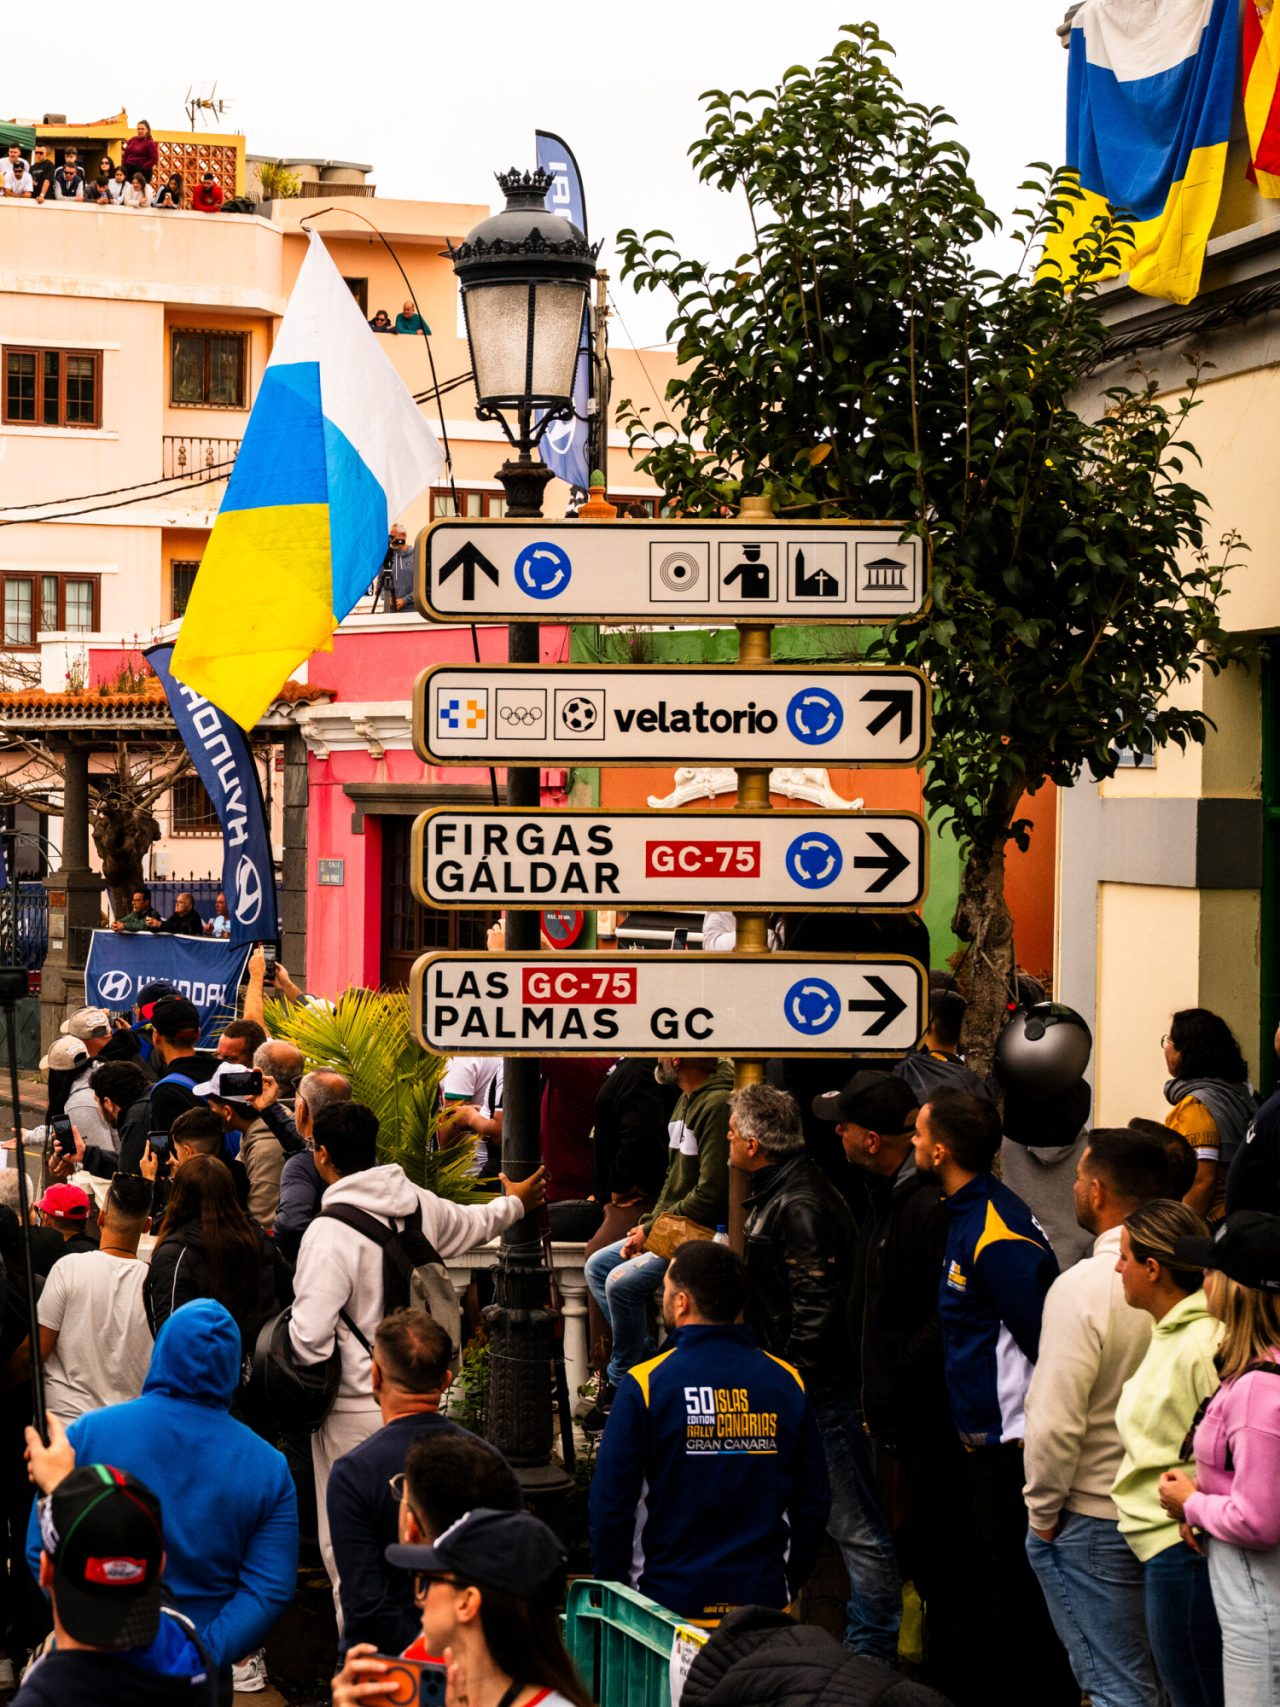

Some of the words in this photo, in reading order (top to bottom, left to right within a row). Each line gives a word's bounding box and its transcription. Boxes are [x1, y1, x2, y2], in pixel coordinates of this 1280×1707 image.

[614, 701, 778, 735] velatorio
[435, 824, 614, 856] FIRGAS
[651, 846, 755, 872] GC-75
[435, 856, 621, 894] GÁLDAR
[435, 970, 509, 1000] LAS
[527, 972, 632, 999] GC-75
[434, 1007, 619, 1039] PALMAS
[651, 1007, 715, 1040] GC
[684, 1387, 715, 1414] 50
[714, 1388, 749, 1412] ISLAS
[687, 1415, 715, 1424] EDITION
[687, 1425, 715, 1437] RALLY
[717, 1413, 778, 1437] CANARIAS
[686, 1439, 721, 1449] GRAN
[724, 1438, 777, 1449] CANARIA
